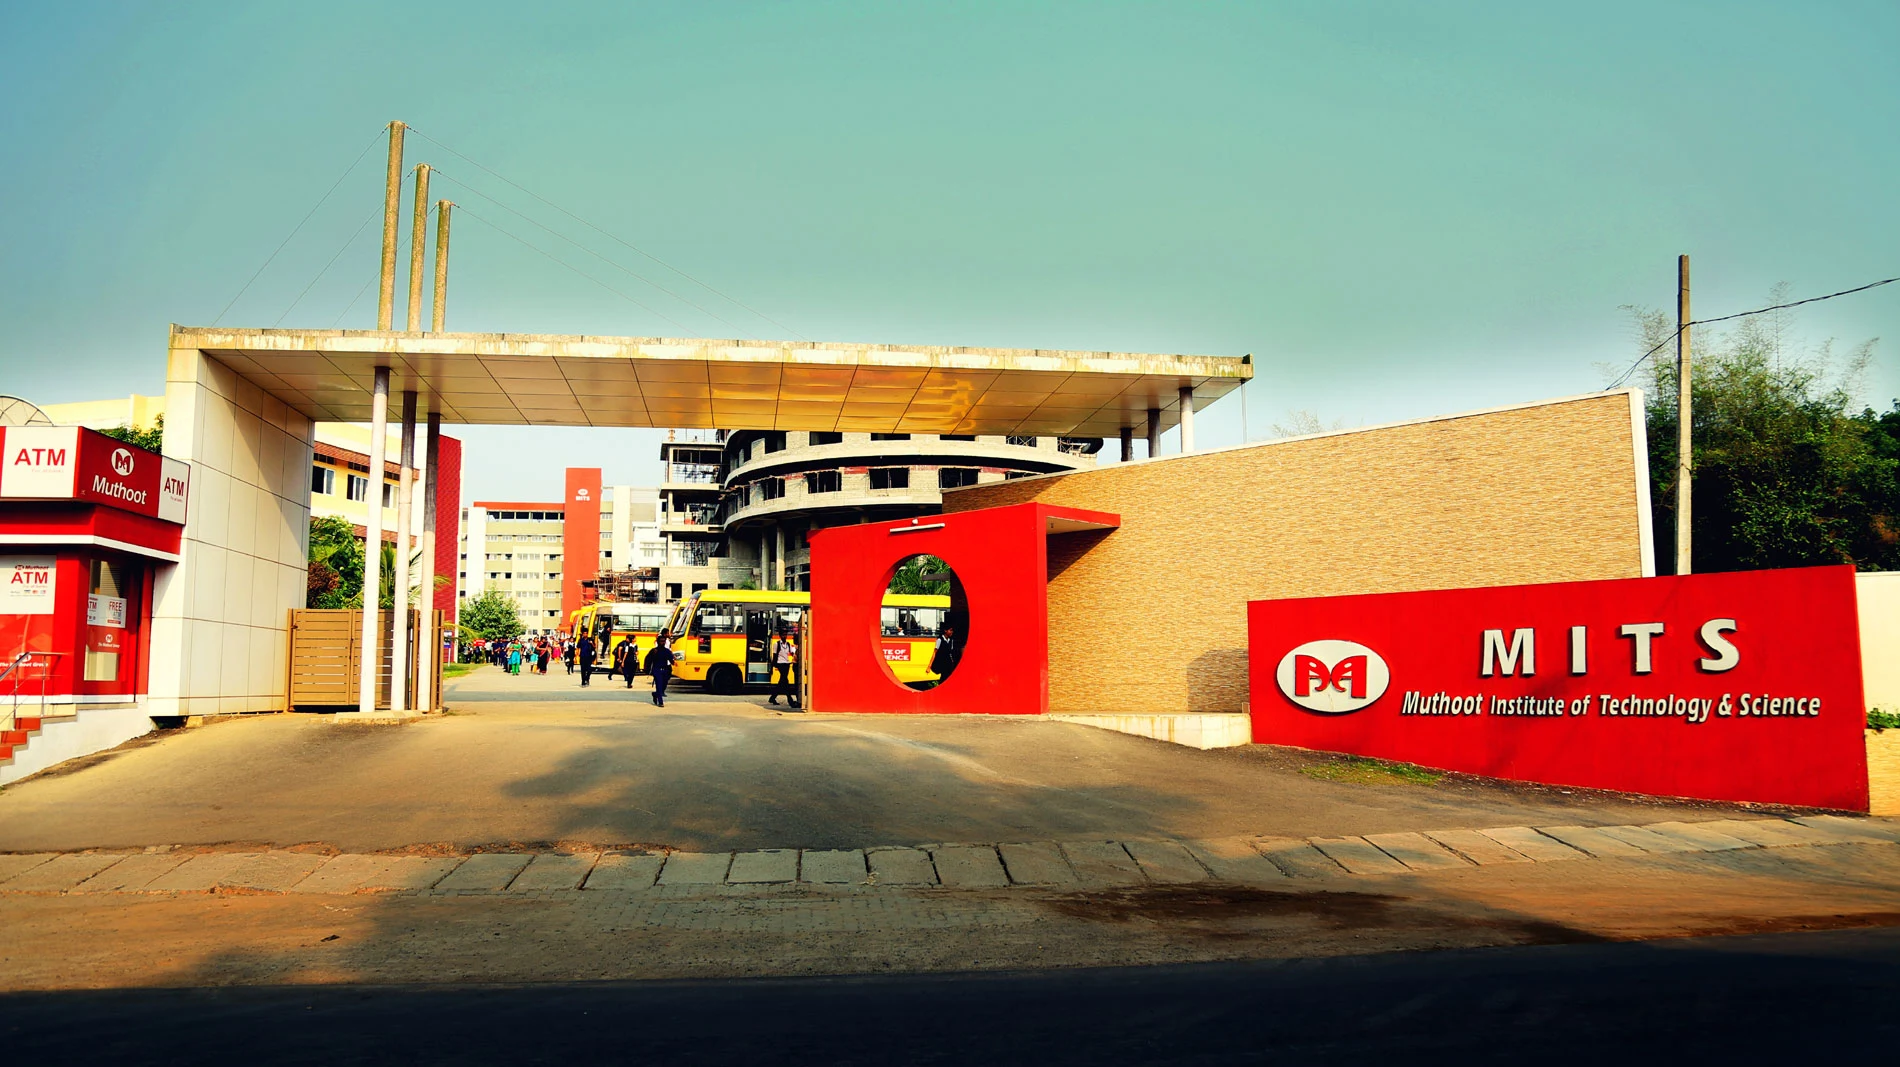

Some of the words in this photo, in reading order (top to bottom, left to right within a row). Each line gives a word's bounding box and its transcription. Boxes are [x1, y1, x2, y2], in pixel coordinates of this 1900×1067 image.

[14, 448, 66, 466] ATM
[92, 474, 147, 505] Muthoot
[164, 477, 185, 497] ATM
[11, 571, 48, 584] ATM
[109, 601, 122, 611] FREE
[1402, 691, 1483, 715] Muthoot
[1490, 695, 1565, 716] Institute
[1571, 695, 1591, 716] of
[1600, 694, 1712, 722] Technology
[1718, 693, 1732, 715] &
[1739, 693, 1821, 716] Science
